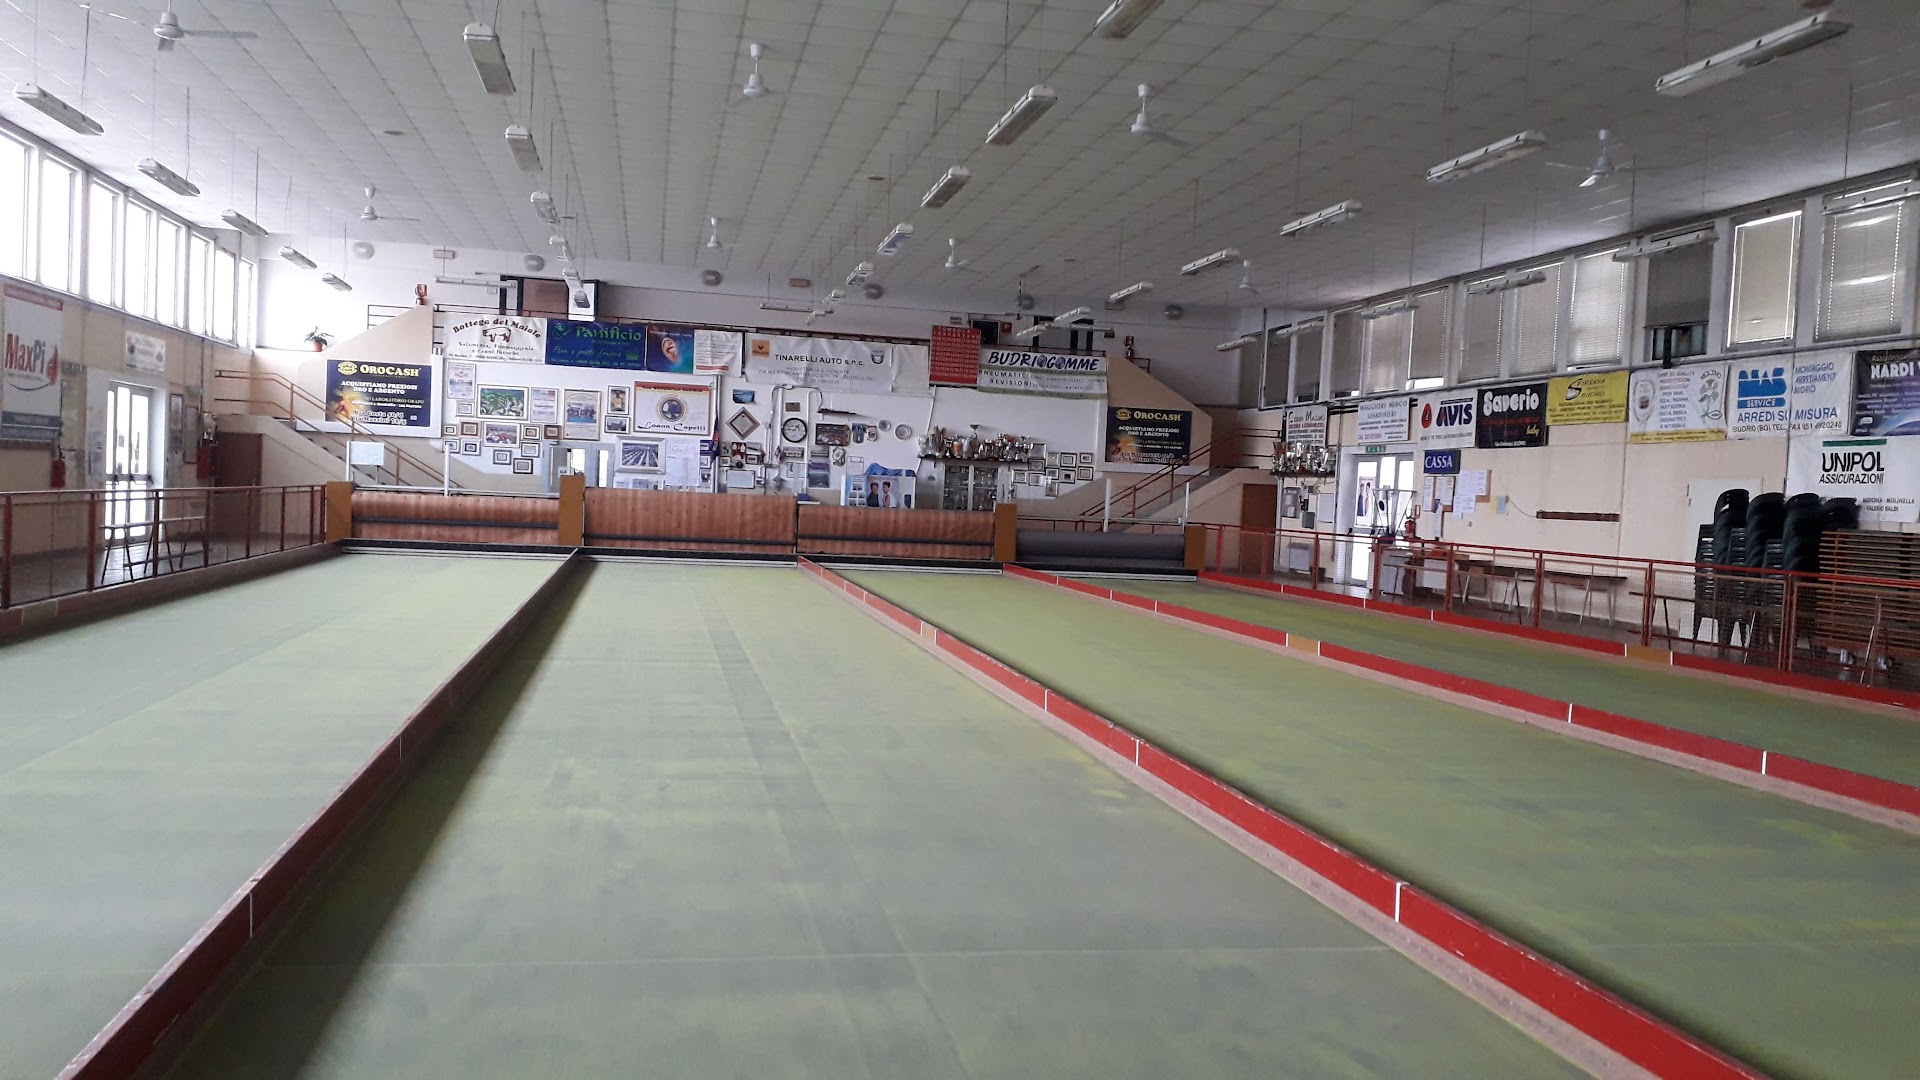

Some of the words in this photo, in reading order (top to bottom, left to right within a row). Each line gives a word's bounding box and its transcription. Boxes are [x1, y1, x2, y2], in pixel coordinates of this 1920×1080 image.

[452, 319, 489, 333] Bottega
[510, 320, 541, 339] Maiale
[576, 326, 641, 340] Panificio
[5, 333, 46, 374] MaxPi
[775, 354, 818, 363] TINARELLI
[820, 356, 842, 365] AUTO
[979, 370, 1030, 379] PNEUMATICI
[1794, 362, 1834, 374] MONTAGGIO
[1870, 361, 1915, 379] NARDI
[341, 381, 386, 389] ACQUISTIAMO
[990, 378, 1032, 387] REVISIONI
[1483, 388, 1540, 417] Saverio
[1746, 398, 1776, 407] SERVICE
[1436, 403, 1473, 427] AVIS
[1737, 411, 1775, 423] ARREDI
[1778, 410, 1791, 421] SU
[1794, 407, 1838, 421] MISURA
[1732, 425, 1756, 433] BUDRIO
[1425, 455, 1453, 469] CASSA
[1821, 451, 1885, 473] UNIPOL
[1818, 473, 1885, 484] ASSICURAZIONI
